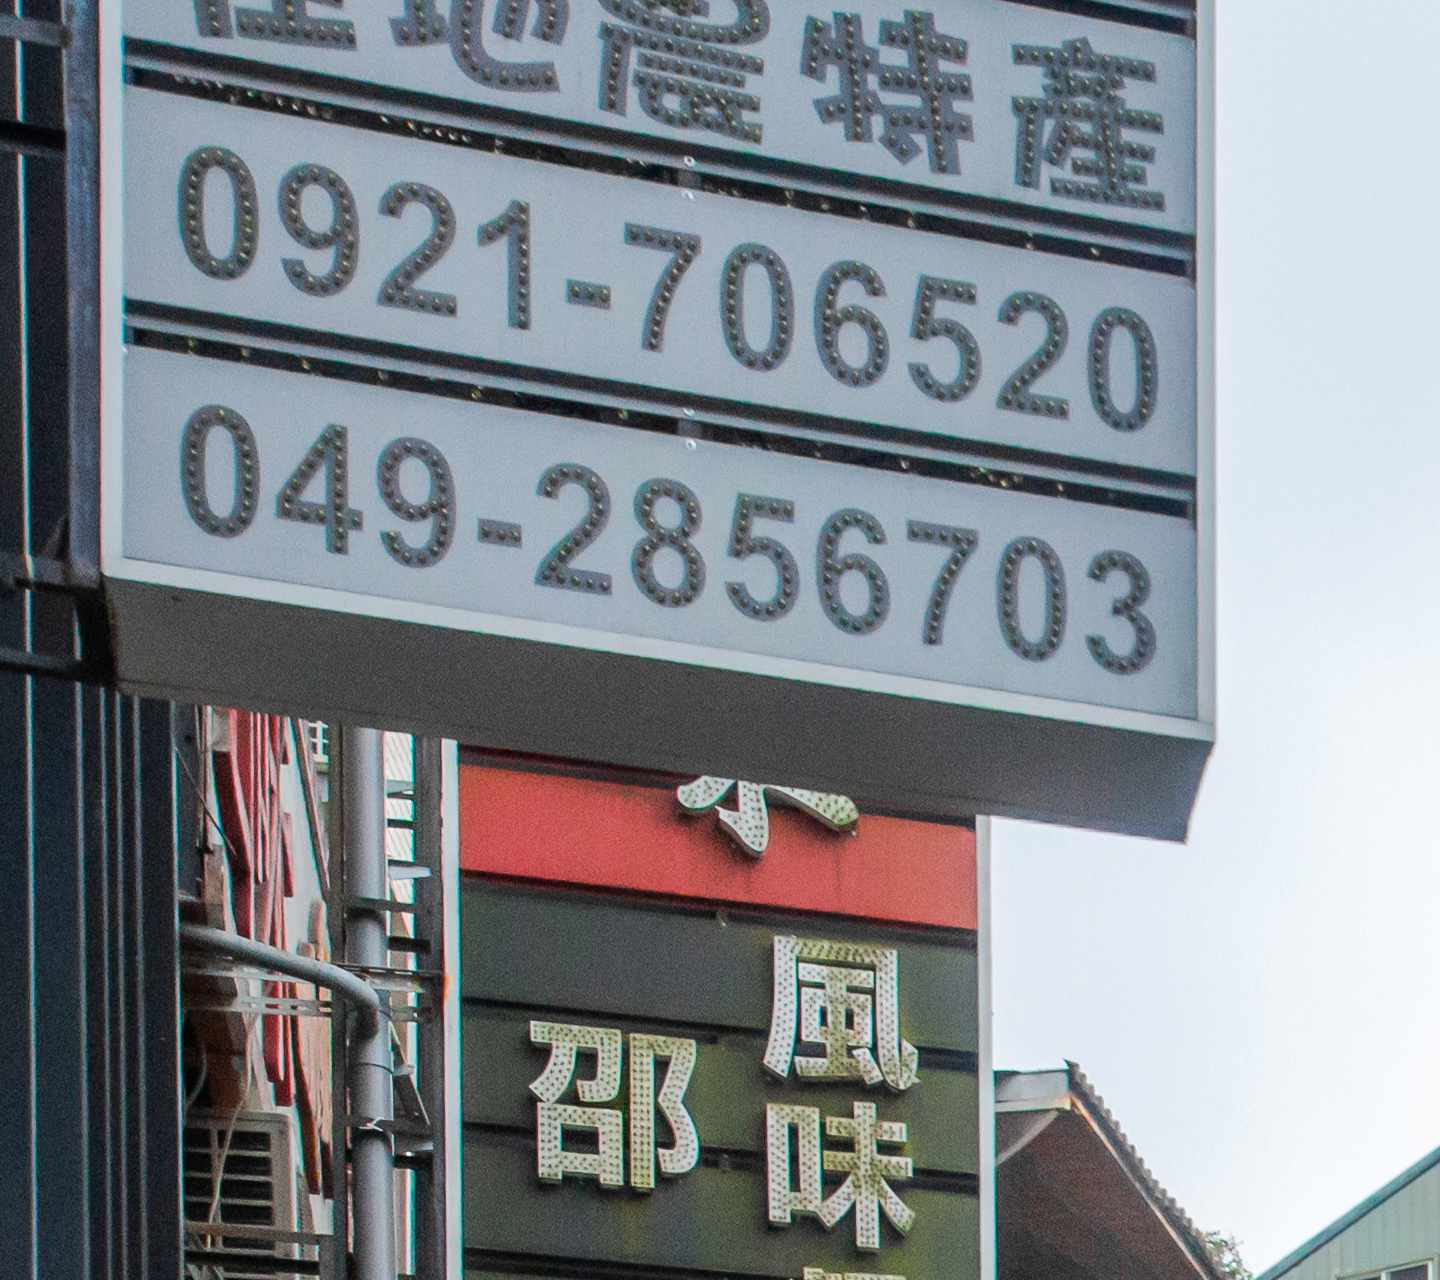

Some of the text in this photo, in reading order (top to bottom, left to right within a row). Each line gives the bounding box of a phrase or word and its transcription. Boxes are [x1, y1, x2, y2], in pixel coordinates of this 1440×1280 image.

[188, 0, 1166, 211] 農特產
[178, 145, 1158, 434] 0921-706520
[180, 404, 1158, 676] 049-2856703
